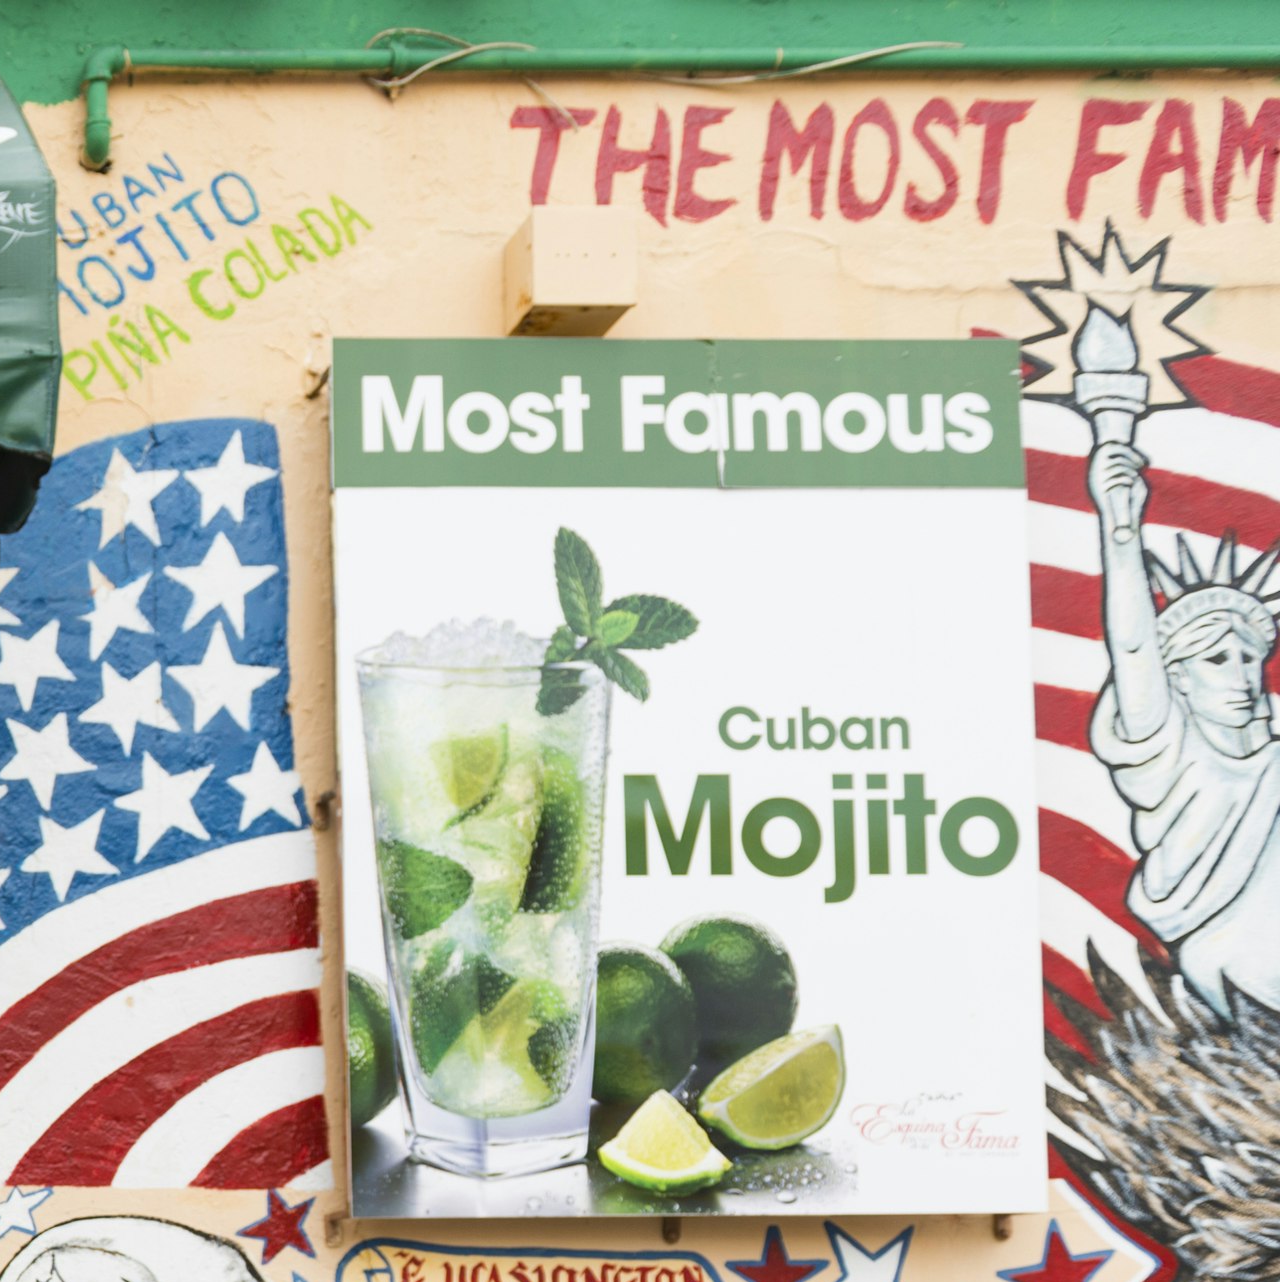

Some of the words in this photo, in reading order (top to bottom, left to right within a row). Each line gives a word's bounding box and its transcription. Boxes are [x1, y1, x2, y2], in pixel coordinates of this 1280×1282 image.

[510, 103, 738, 228] THE
[759, 97, 1036, 225] MOST
[1066, 97, 1280, 226] FAM
[62, 304, 192, 401] PIÑA
[185, 194, 374, 321] COLADA
[360, 374, 590, 454] Most
[621, 374, 995, 454] Famous
[717, 705, 910, 751] Cuban
[623, 773, 1020, 903] Mojito
